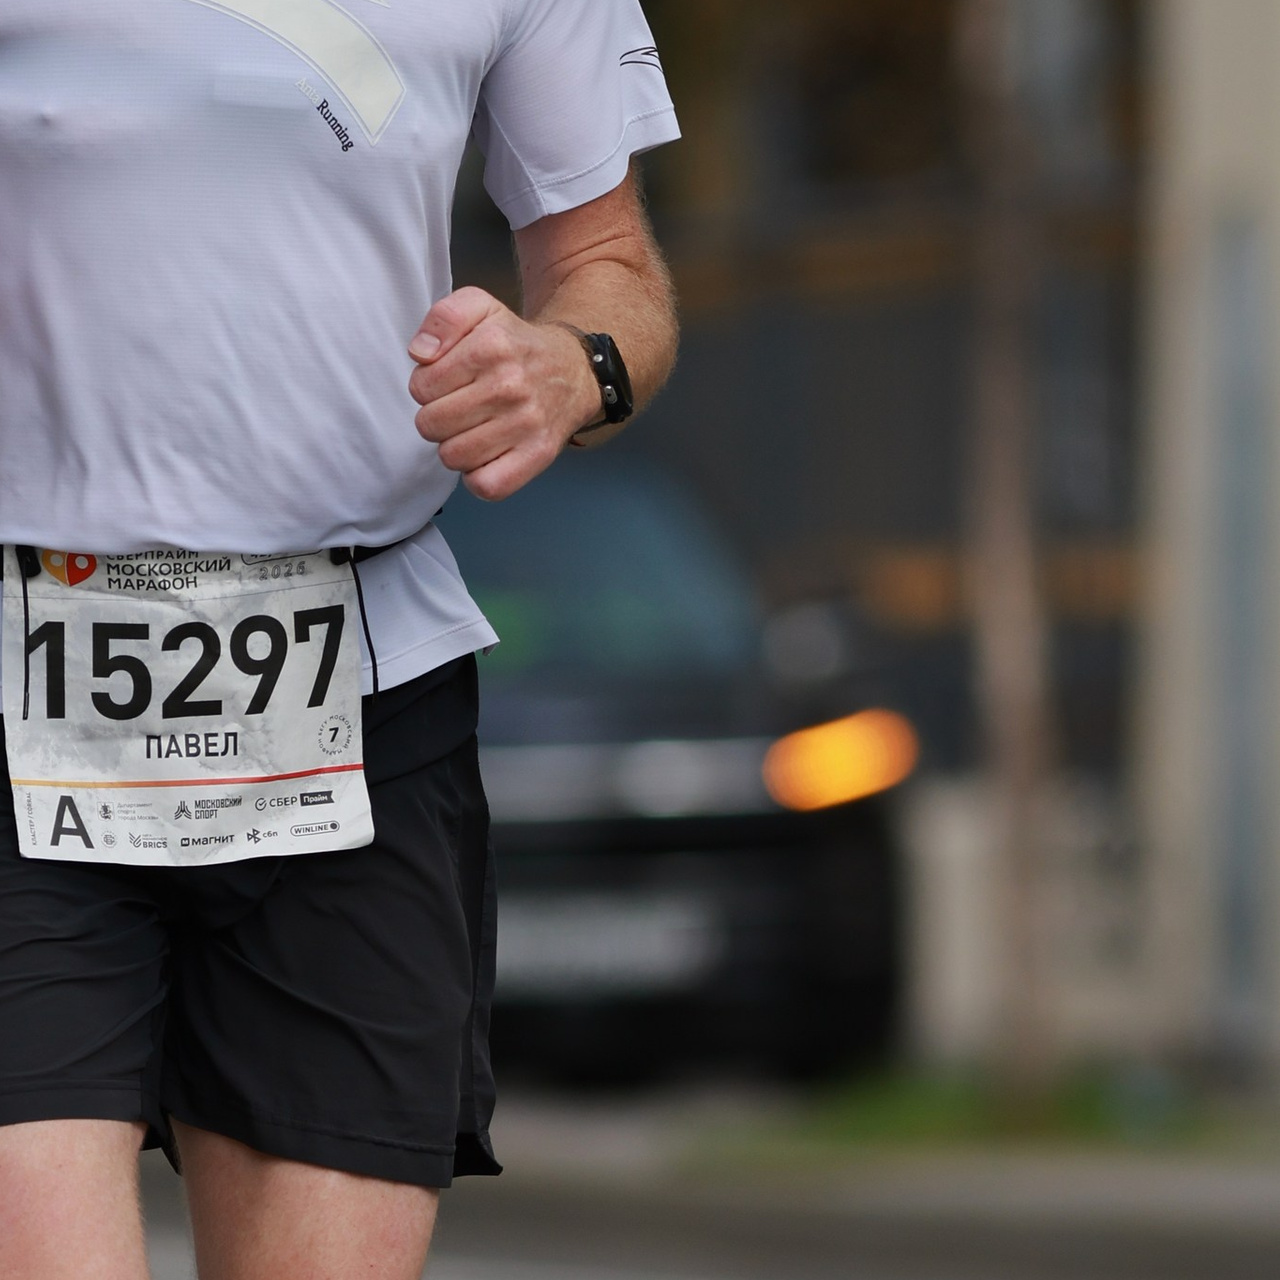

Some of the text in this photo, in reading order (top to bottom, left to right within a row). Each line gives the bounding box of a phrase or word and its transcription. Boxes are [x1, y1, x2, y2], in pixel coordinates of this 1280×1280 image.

[316, 98, 354, 152] Running
[107, 557, 231, 577] МОСКОВСКИЙ
[259, 561, 306, 581] 2026
[107, 576, 198, 591] МАРАФОН
[28, 604, 345, 721] 15297
[329, 726, 340, 743] 7
[145, 731, 239, 759] ПАВЕЛ
[194, 795, 243, 809] МОСКОВСКИЙ
[269, 794, 328, 807] СБЕР Прайм
[194, 809, 218, 820] СПОРТ
[294, 824, 329, 834] WINLINE
[142, 841, 168, 849] BRICS
